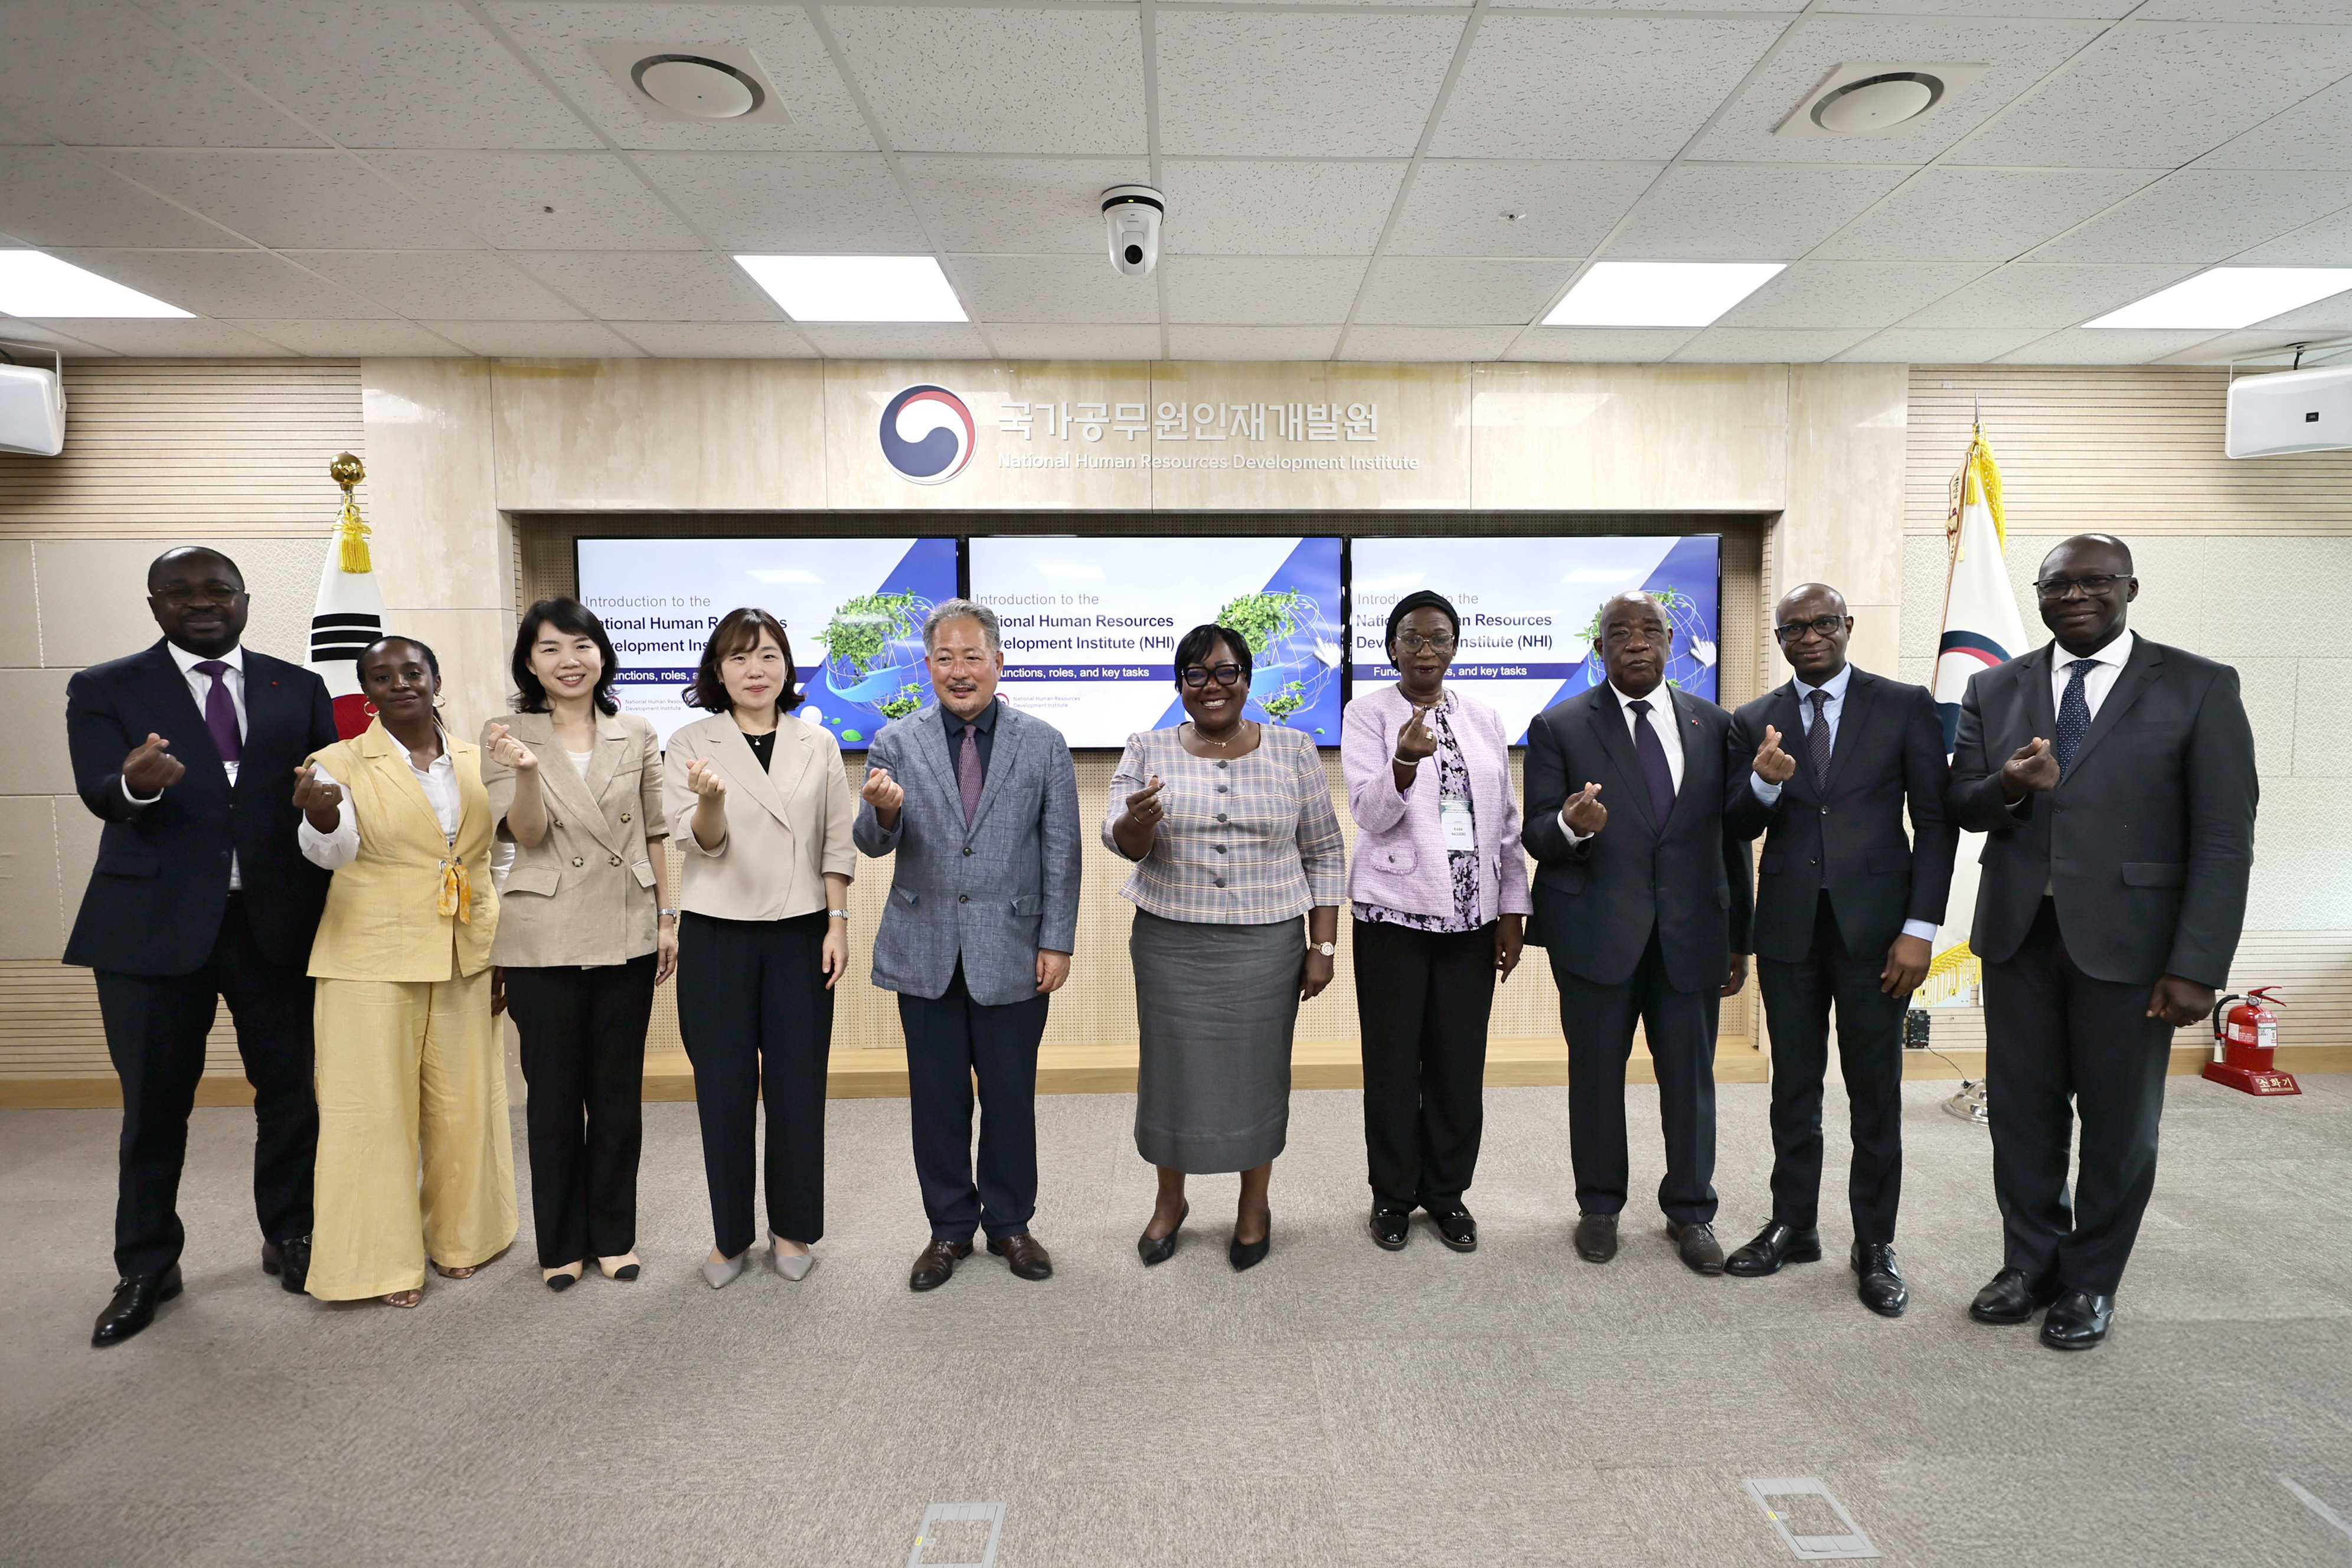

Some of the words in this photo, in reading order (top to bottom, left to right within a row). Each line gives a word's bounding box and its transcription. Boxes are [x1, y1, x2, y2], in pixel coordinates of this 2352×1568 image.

[998, 401, 1377, 442] 국가공무원인재개발원
[998, 453, 1070, 468] National
[1076, 453, 1136, 468] Human
[1141, 453, 1229, 469] Resources
[1233, 455, 1345, 472] Development
[1351, 455, 1419, 470] Institute
[585, 595, 667, 607] Introduction
[672, 596, 685, 607] to
[690, 595, 711, 607] the
[976, 593, 1056, 605] Introduction
[1061, 594, 1073, 605] to
[1079, 593, 1099, 605] the
[1358, 593, 1403, 605] Introdu
[1458, 593, 1478, 604] the
[599, 617, 646, 630] tional
[650, 617, 704, 629] Human
[996, 615, 1034, 627] ional
[1039, 615, 1092, 627] Human
[1096, 615, 1174, 627] Resources
[1475, 613, 1552, 626] Resources
[611, 639, 685, 655] elopment
[1001, 636, 1073, 652] elopment
[1077, 636, 1135, 649] Institute
[1139, 636, 1175, 652] (NHI)
[1458, 635, 1514, 648] nstitute
[1518, 635, 1553, 651] (NHI)
[613, 670, 658, 681] unctions,
[661, 670, 690, 681] roles,
[1001, 668, 1046, 679] unctions,
[1048, 667, 1077, 679] roles,
[1079, 667, 1099, 677] and
[1102, 667, 1121, 680] key
[1122, 667, 1150, 677] tasks
[1458, 666, 1478, 676] and
[1480, 666, 1498, 678] key
[1500, 665, 1528, 676] tasks
[2259, 1077, 2293, 1088] 소화기
